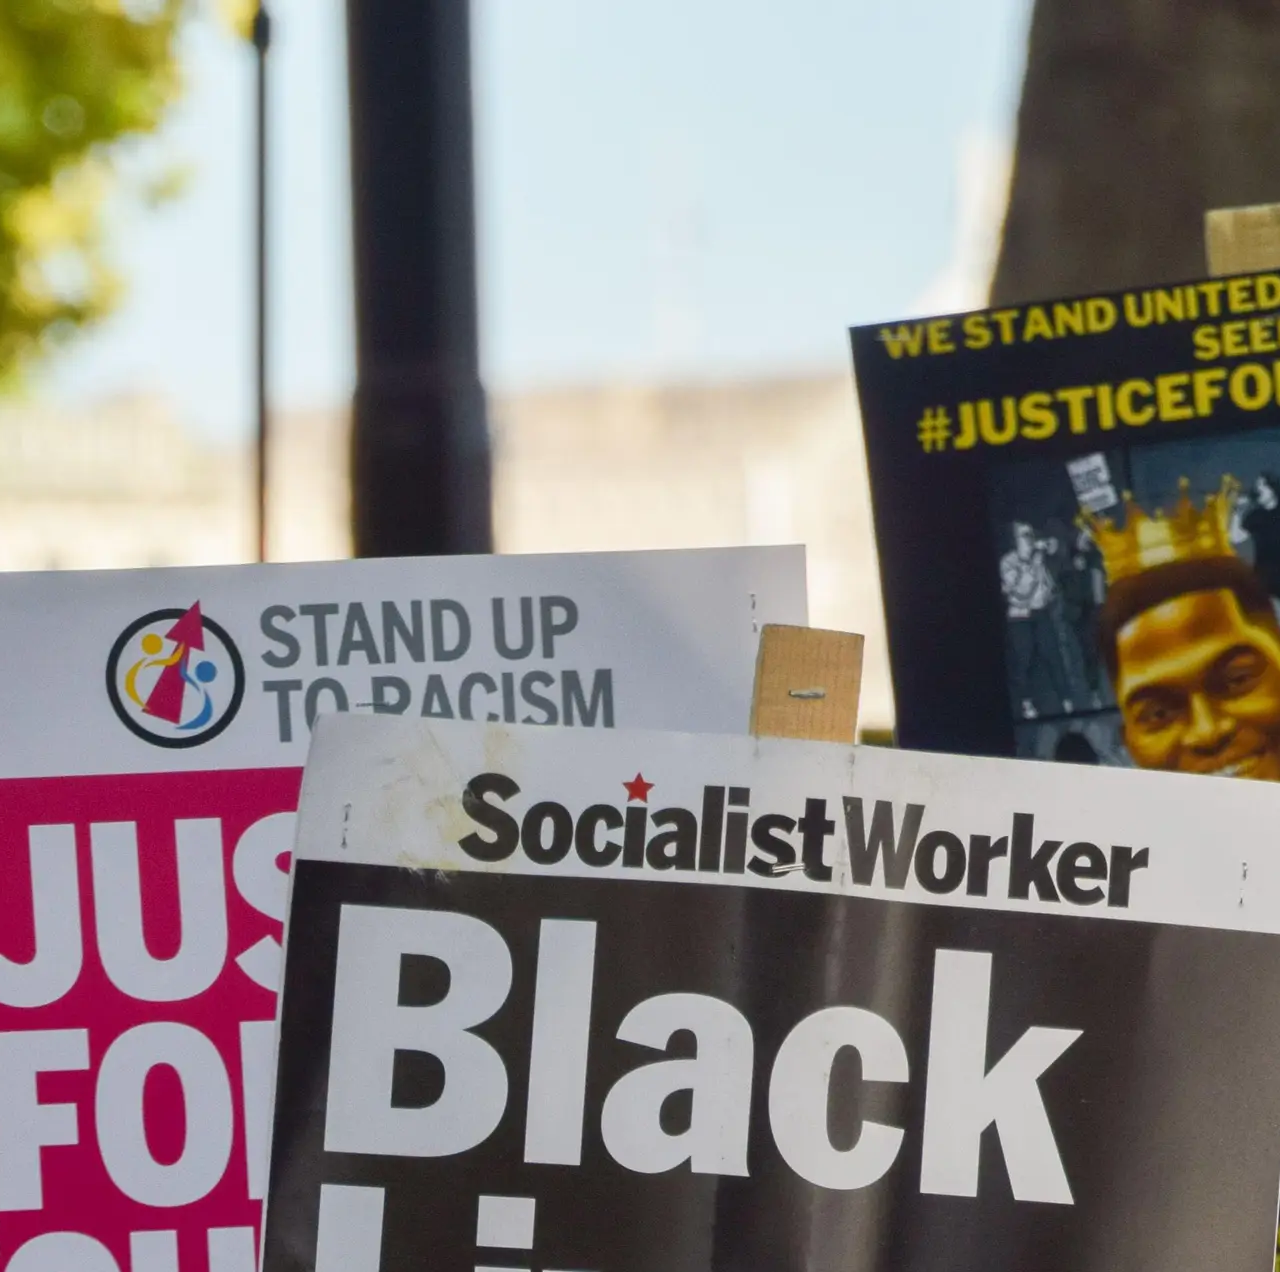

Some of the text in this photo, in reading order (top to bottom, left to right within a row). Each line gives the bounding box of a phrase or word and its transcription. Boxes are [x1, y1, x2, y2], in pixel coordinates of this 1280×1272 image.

[883, 318, 956, 361] WE
[965, 298, 1116, 351] STAND
[260, 595, 579, 669] STAND UP
[262, 676, 350, 743] TO
[322, 903, 1085, 1205] Black
